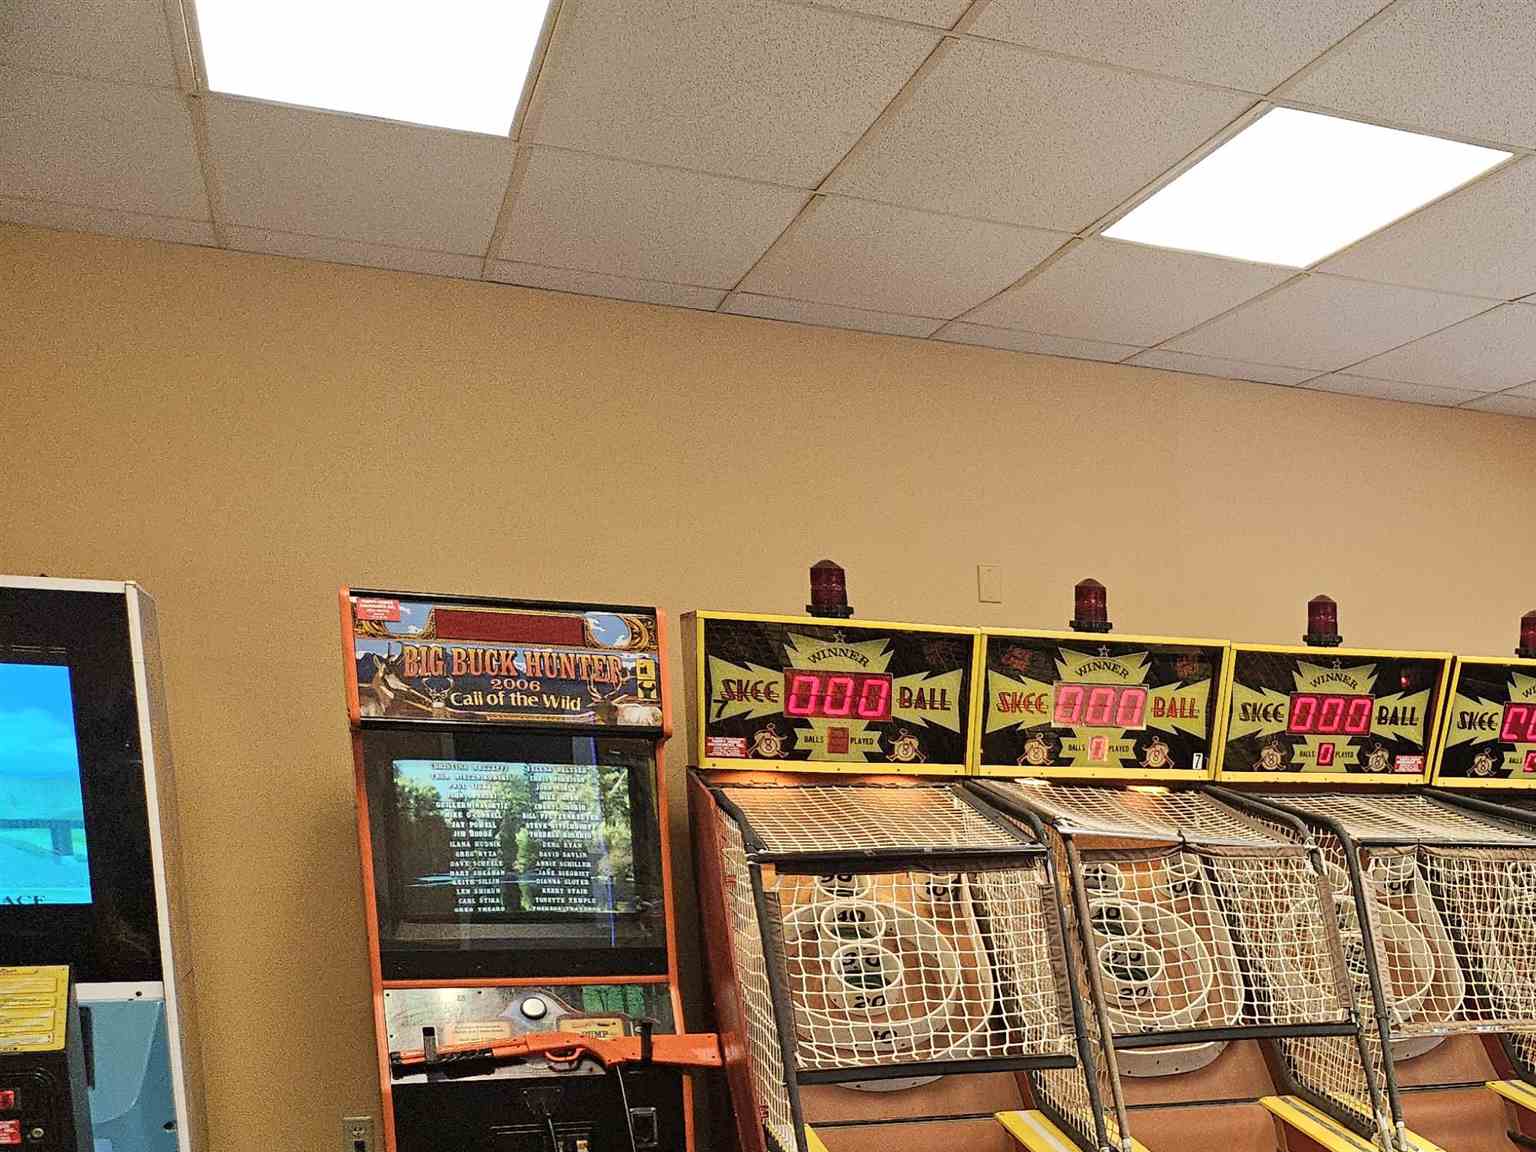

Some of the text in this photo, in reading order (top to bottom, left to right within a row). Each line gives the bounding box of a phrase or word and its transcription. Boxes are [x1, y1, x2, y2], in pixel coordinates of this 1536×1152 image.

[402, 646, 622, 683] BIG BUCK HUNTER
[808, 648, 869, 667] WINNER
[1075, 661, 1129, 680] WINNER
[490, 678, 541, 691] 2006
[1310, 673, 1357, 689] WINNER
[451, 691, 581, 711] Call of the Wild
[720, 679, 951, 711] SKEE BALL
[997, 692, 1199, 719] SKEE BALL
[1239, 703, 1418, 726] SKEE BALL
[1457, 711, 1498, 730] SKEE
[804, 735, 874, 746] BALLS PLAYED
[1319, 744, 1332, 763] 0
